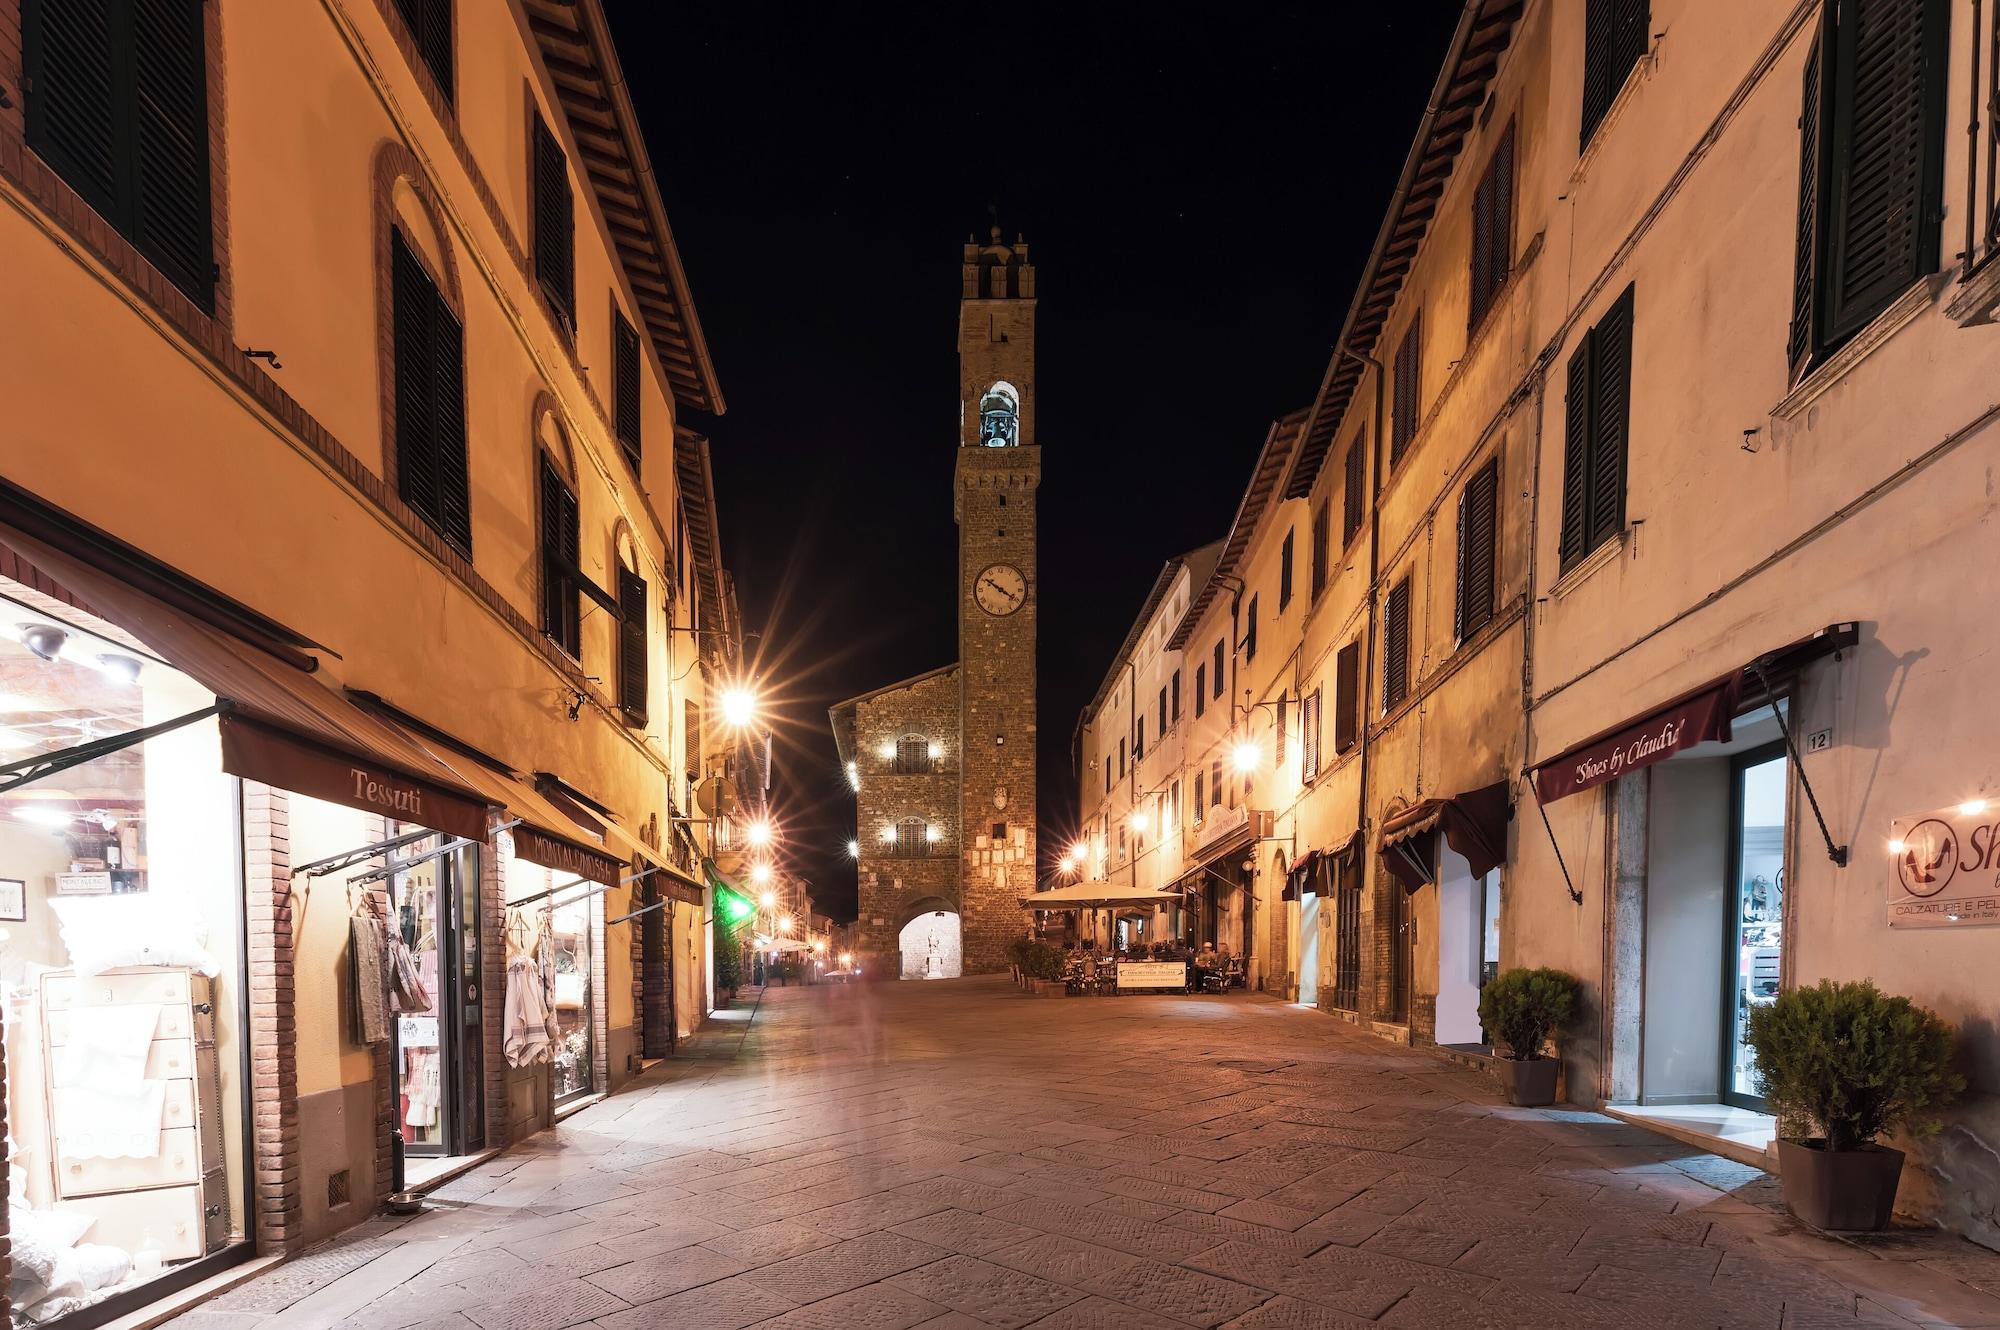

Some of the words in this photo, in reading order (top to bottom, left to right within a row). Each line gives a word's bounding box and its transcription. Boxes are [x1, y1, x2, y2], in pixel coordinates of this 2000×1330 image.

[1811, 733, 1826, 749] 12
[1610, 747, 1625, 775] by
[350, 768, 422, 815] Tessuti
[1896, 902, 1960, 915] CALZATURE
[1965, 901, 1973, 911] E
